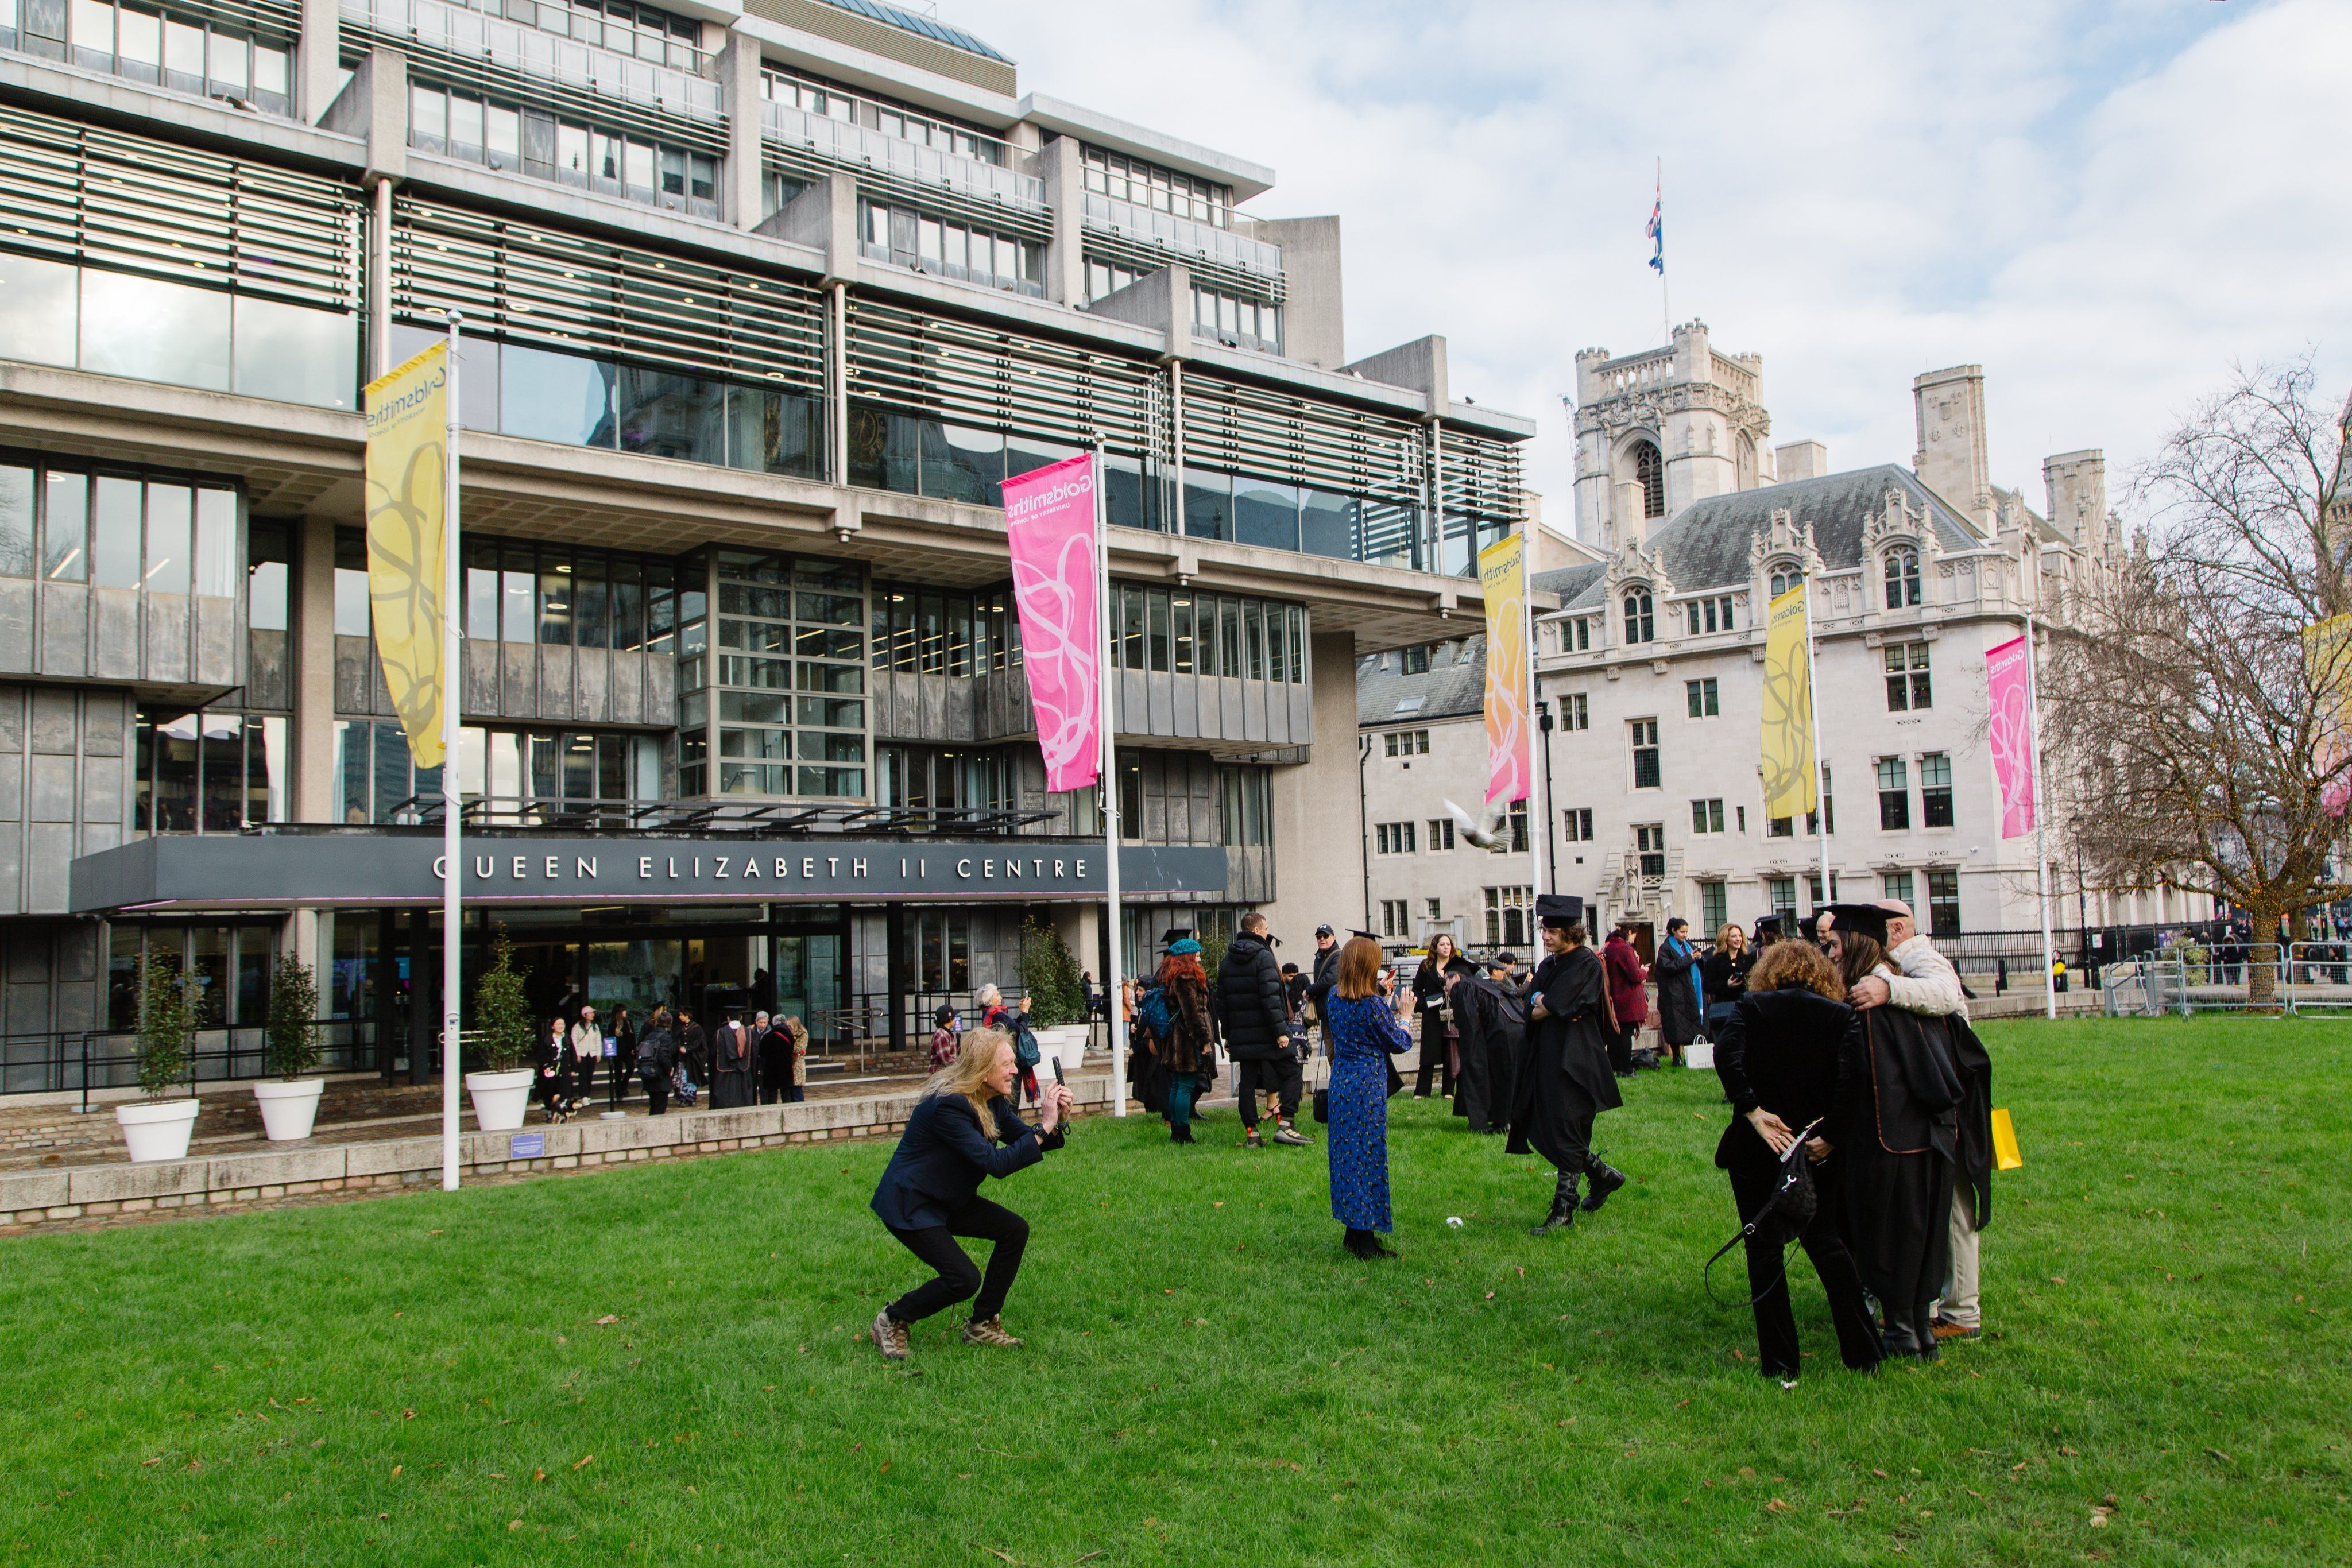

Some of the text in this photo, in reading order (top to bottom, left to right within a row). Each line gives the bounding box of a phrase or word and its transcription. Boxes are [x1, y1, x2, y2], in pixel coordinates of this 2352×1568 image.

[640, 857, 868, 878] ELIZABETH
[902, 858, 924, 877] II
[957, 858, 1085, 878] CENTRE
